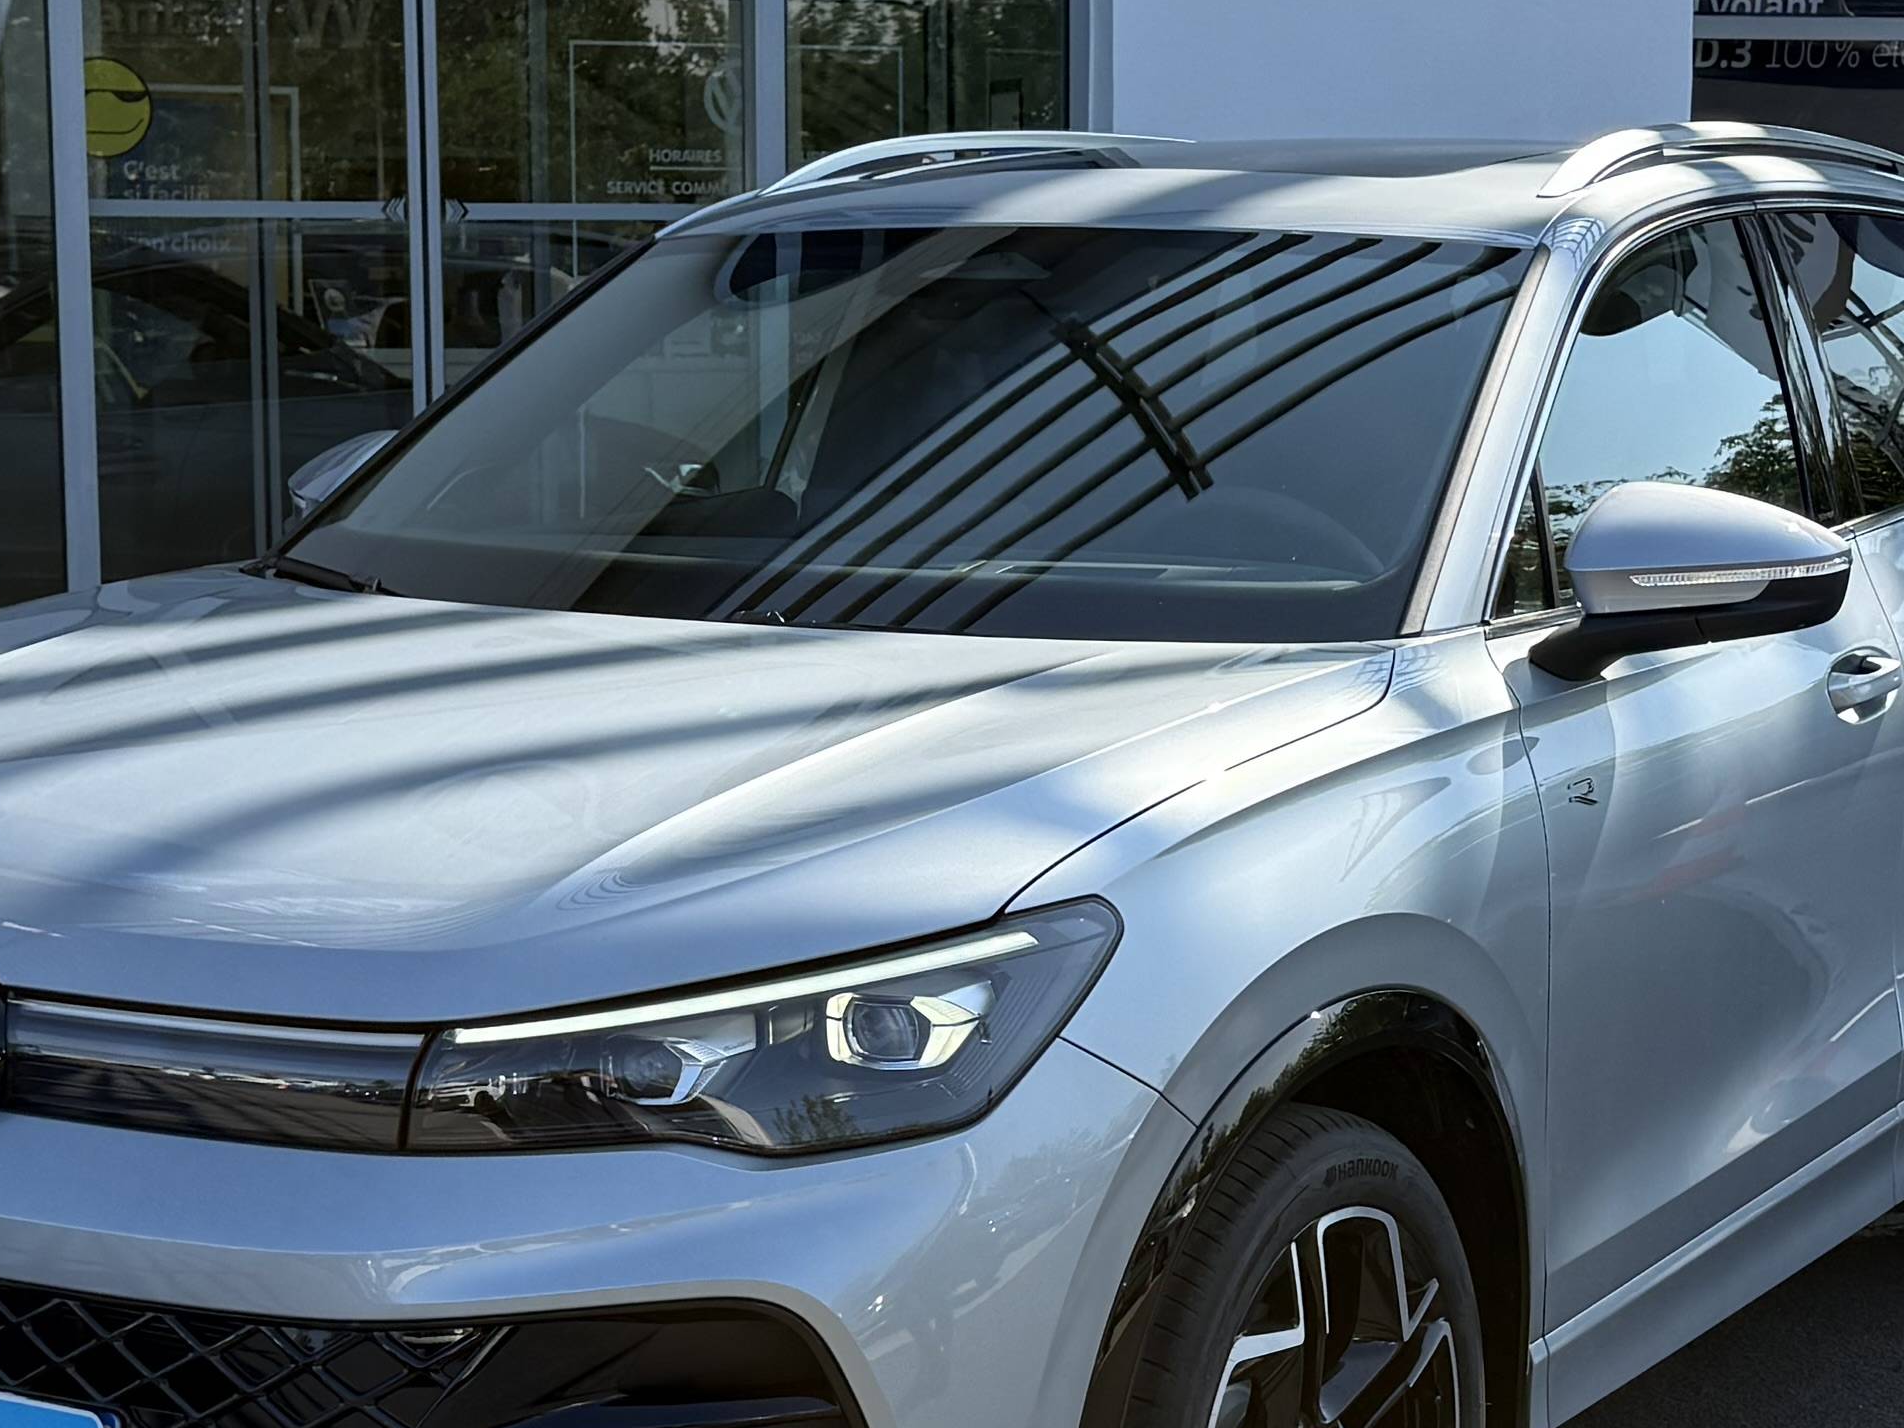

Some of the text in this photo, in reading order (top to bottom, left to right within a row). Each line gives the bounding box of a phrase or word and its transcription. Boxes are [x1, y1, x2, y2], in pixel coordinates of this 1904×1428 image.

[648, 148, 723, 163] HORAIRES
[122, 160, 182, 182] C'est
[606, 180, 665, 195] SERVICE
